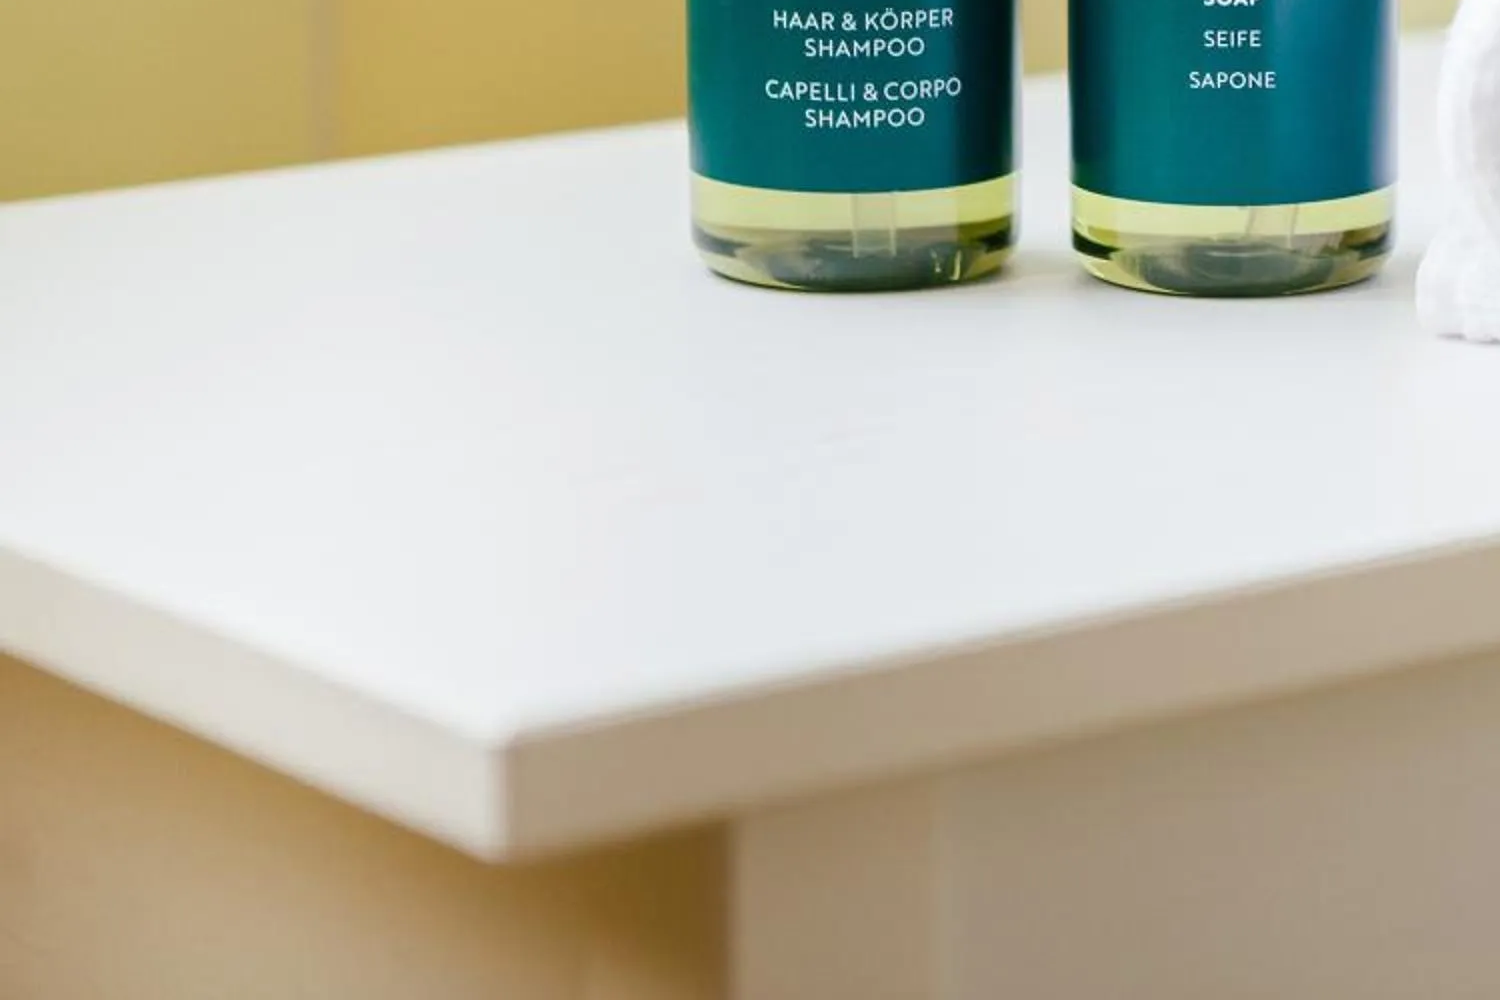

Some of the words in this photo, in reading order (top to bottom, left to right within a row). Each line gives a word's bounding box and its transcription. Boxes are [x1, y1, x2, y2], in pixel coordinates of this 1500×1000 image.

[773, 9, 835, 31] HAAR
[841, 11, 857, 32] &
[864, 7, 954, 31] KÖRPER
[804, 36, 925, 58] SHAMPOO
[1203, 29, 1262, 48] SEIFE
[764, 78, 856, 102] CAPELLI
[862, 82, 879, 102] &
[883, 76, 962, 101] CORPO
[1188, 71, 1277, 90] SAPONE
[804, 106, 926, 129] SHAMPOO
